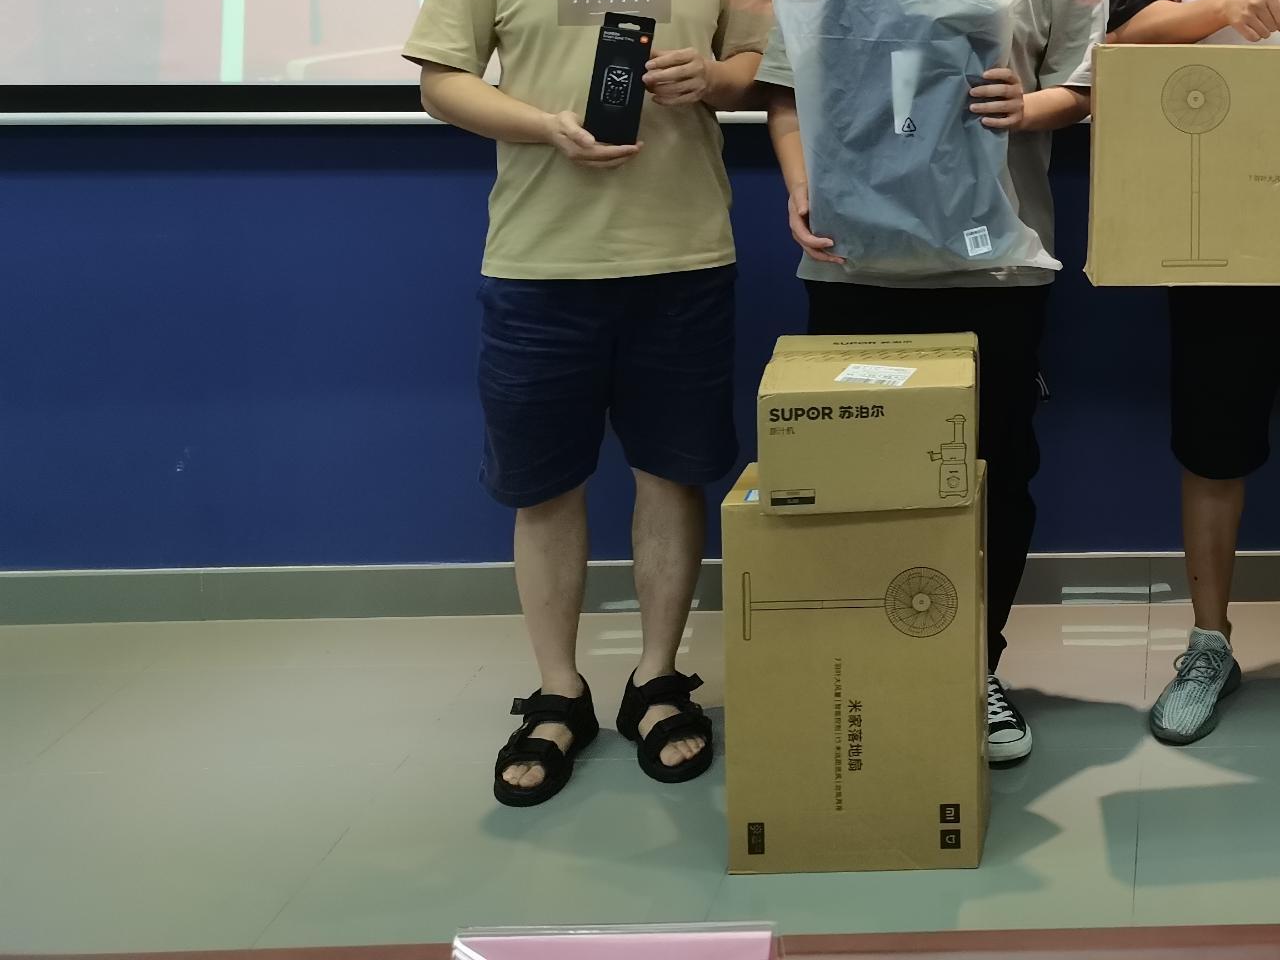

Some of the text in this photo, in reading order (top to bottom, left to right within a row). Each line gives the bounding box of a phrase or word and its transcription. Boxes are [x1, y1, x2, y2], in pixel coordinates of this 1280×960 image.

[769, 405, 886, 423] SUPOR 苏泊尔
[847, 699, 863, 772] 米家落地扇
